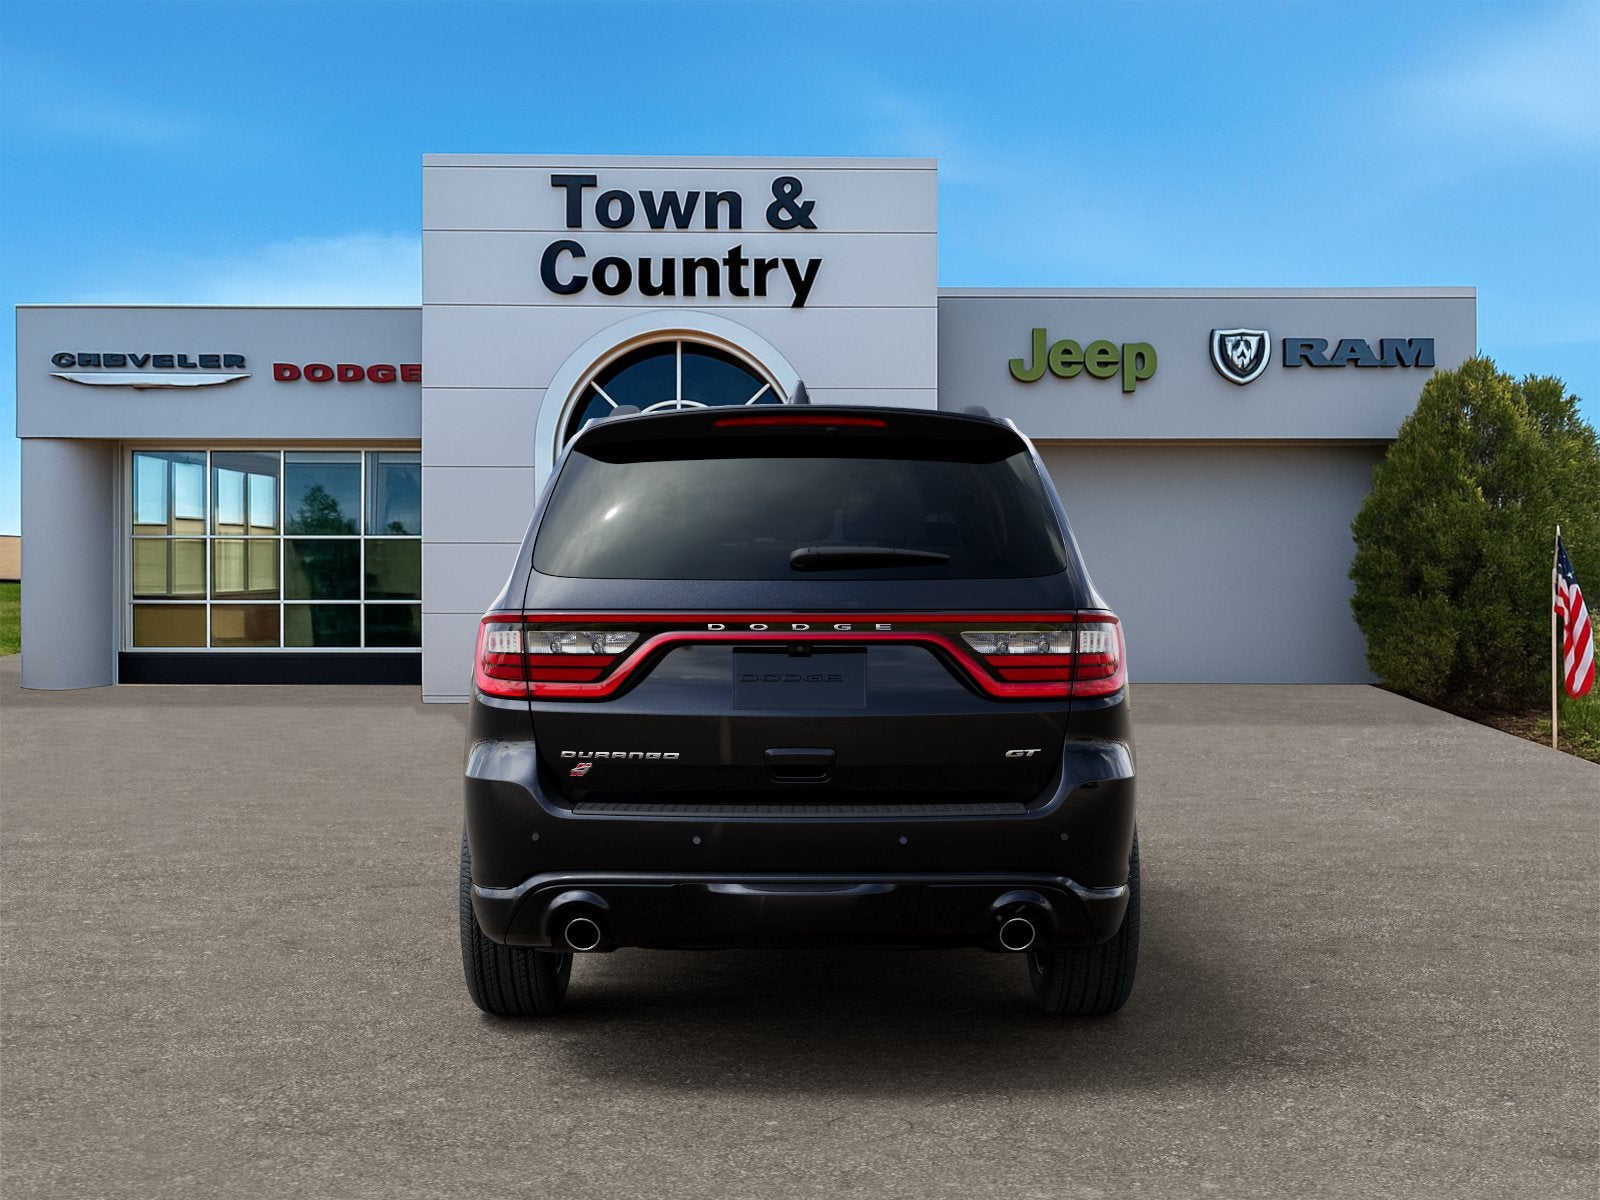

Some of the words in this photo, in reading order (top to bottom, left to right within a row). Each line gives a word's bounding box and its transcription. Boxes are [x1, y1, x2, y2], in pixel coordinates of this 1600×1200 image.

[550, 174, 743, 230] Town
[765, 176, 818, 230] &
[540, 239, 823, 308] Country
[1008, 327, 1158, 393] Jeep
[1282, 336, 1436, 369] RAM
[272, 362, 422, 383] DODGE
[707, 623, 893, 631] DODGE
[738, 673, 844, 683] DODGE
[560, 750, 681, 760] DURANGO
[1005, 748, 1042, 758] GT
